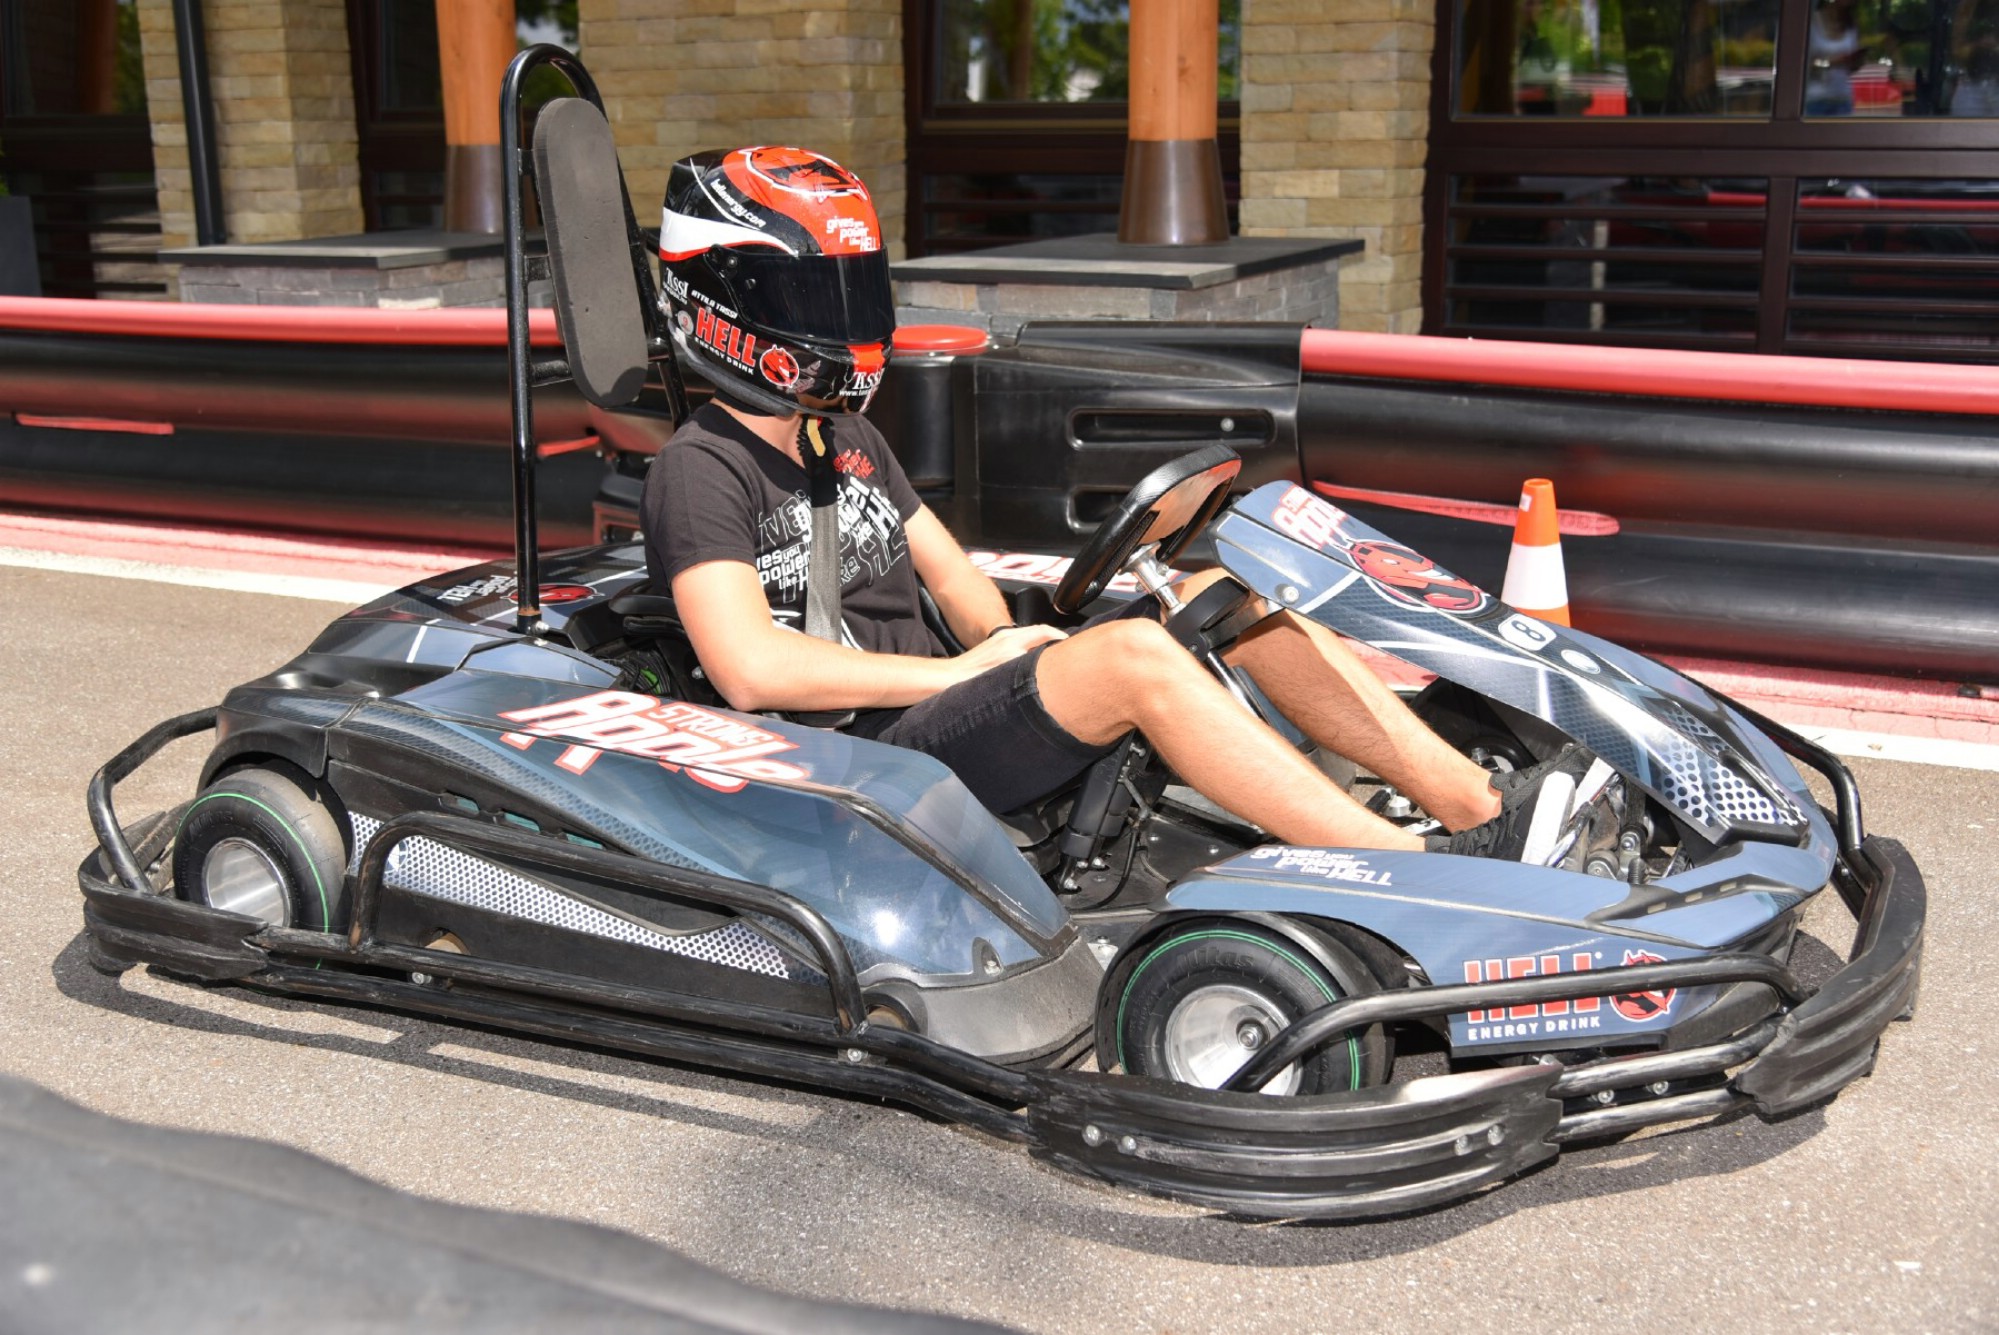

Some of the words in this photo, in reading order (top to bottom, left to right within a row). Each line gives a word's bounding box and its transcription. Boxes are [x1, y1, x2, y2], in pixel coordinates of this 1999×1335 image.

[696, 307, 757, 368] HELL
[726, 356, 754, 375] DRINK
[782, 546, 800, 562] you
[647, 703, 777, 748] STRONG
[1250, 846, 1327, 859] gives
[1274, 856, 1369, 869] power
[1326, 867, 1392, 886] HELL
[1467, 1022, 1539, 1042] ENERGY
[1545, 1015, 1601, 1033] DRINK
